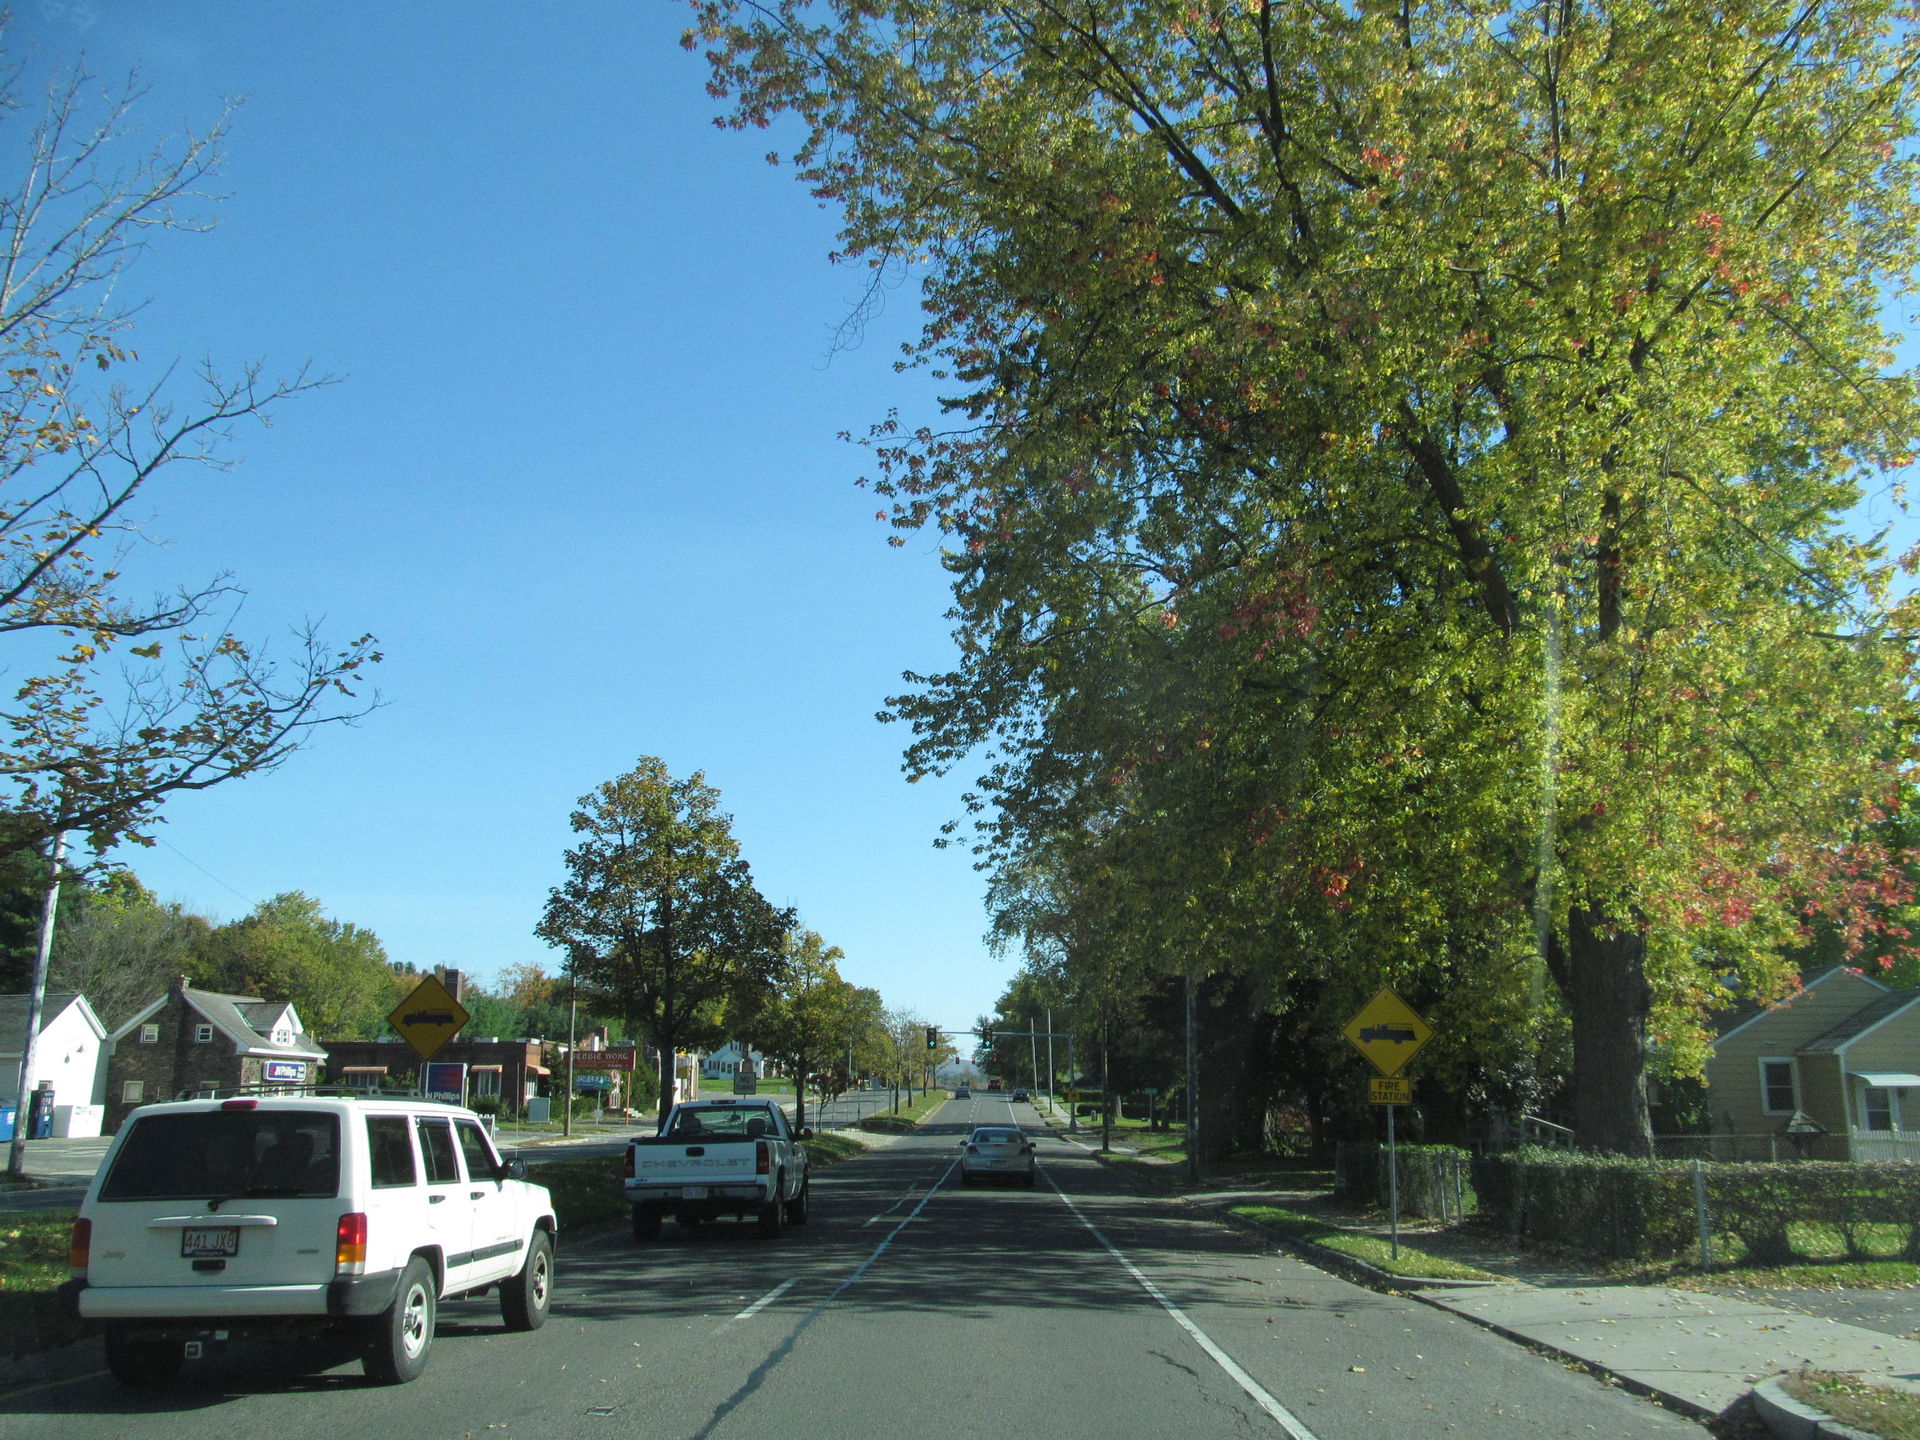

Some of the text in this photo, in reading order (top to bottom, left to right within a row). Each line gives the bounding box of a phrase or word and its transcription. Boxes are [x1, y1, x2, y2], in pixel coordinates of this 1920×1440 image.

[1378, 1081, 1400, 1091] FIRE
[433, 1091, 460, 1102] Phillips
[1371, 1091, 1409, 1101] STATION
[641, 1158, 752, 1168] CHEVROLET
[185, 1232, 208, 1248] 441
